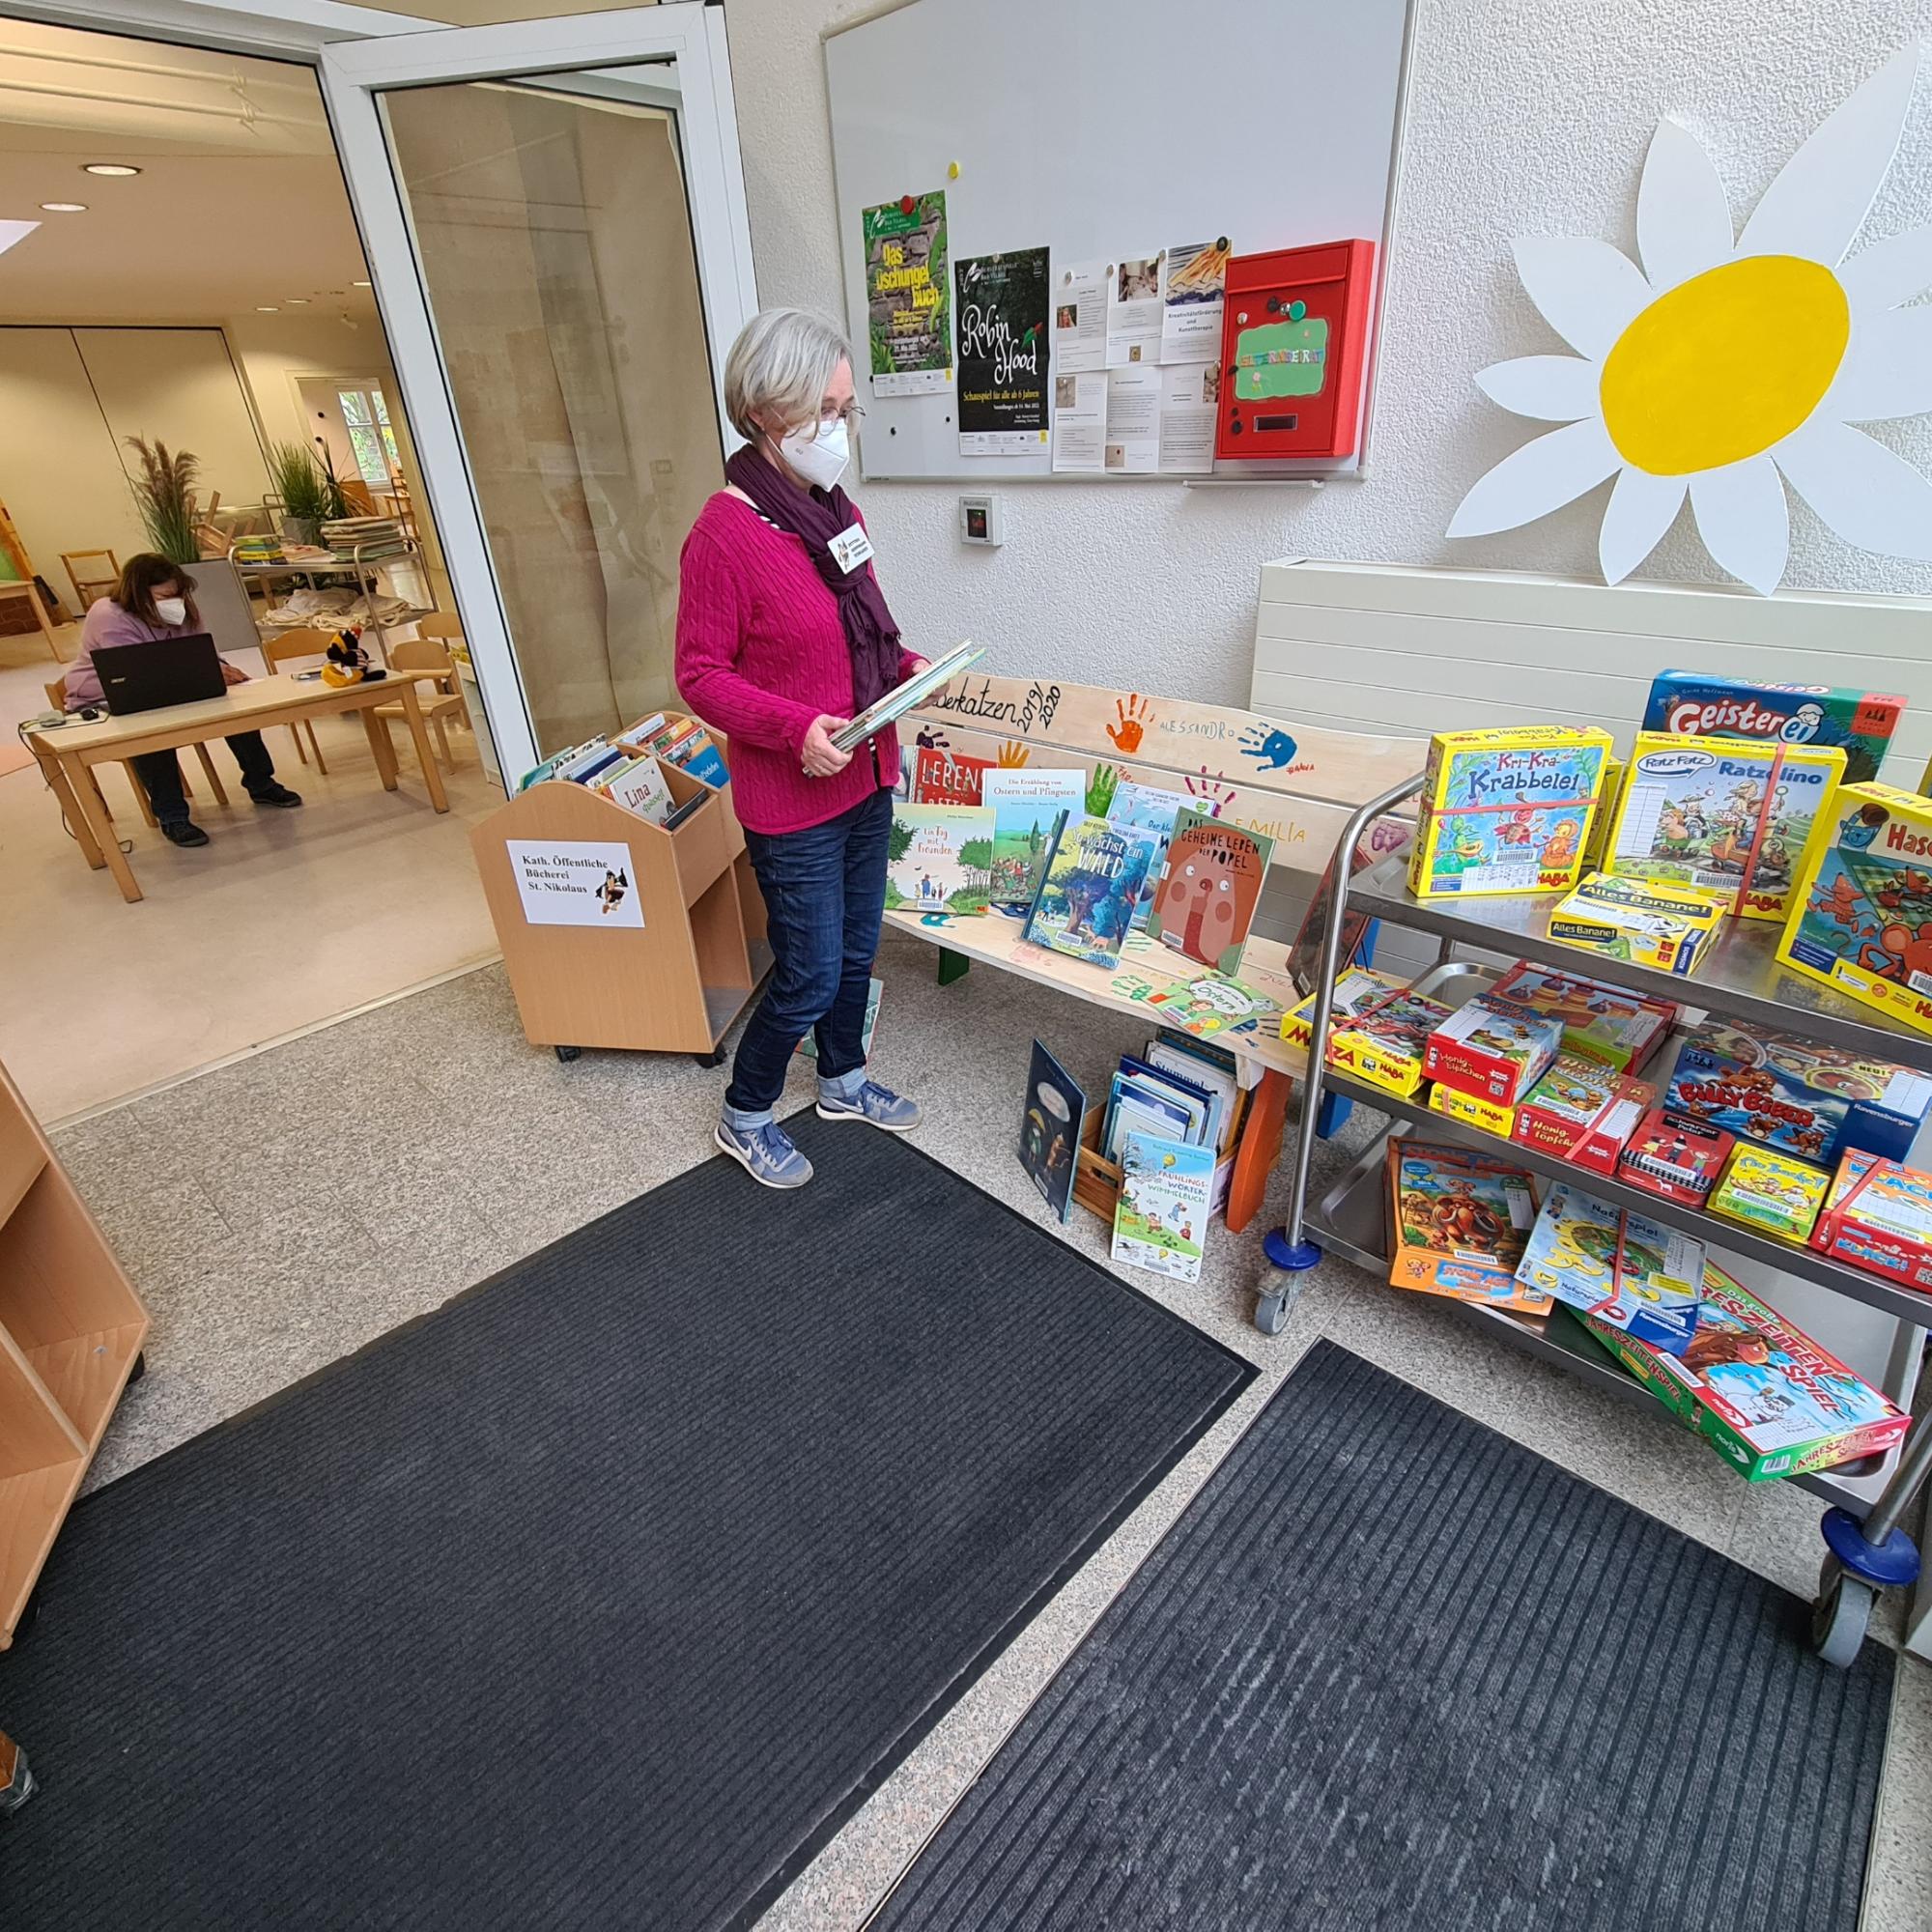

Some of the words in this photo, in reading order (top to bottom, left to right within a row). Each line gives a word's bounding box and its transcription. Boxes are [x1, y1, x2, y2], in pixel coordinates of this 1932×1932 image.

[882, 243, 903, 267] Das
[962, 303, 1011, 358] Robin
[993, 337, 1038, 385] Hood
[963, 389, 992, 403] Schauspiel
[933, 676, 1016, 724] erkatzen
[1645, 757, 1676, 769] Ratz
[1676, 754, 1707, 766] Fatz
[921, 757, 982, 795] LEBEN
[1467, 768, 1580, 800] Krabbelei
[624, 783, 651, 810] Lina
[993, 786, 1021, 796] Ostern
[1022, 786, 1037, 796] und
[1039, 786, 1076, 798] Pfingsten
[1187, 818, 1204, 829] DAS
[918, 841, 952, 855] Freunden
[1126, 845, 1144, 859] ein
[1180, 829, 1223, 847] GEHEIME
[1226, 836, 1261, 855] LEBEN
[522, 855, 551, 867] Kath.
[553, 855, 609, 868] Öffentliche
[1077, 846, 1124, 878] WALD
[1210, 848, 1248, 869] POPEL
[526, 867, 570, 880] Bücherei
[527, 881, 542, 891] St.
[544, 882, 587, 894] Nikolaus
[1582, 886, 1627, 901] Alles
[1629, 895, 1708, 915] Banane!
[1552, 922, 1576, 933] Alles
[1577, 924, 1616, 938] Banane!
[1678, 945, 1690, 970] KOSMOS
[1381, 1050, 1412, 1067] HABA
[1858, 1065, 1887, 1076] NEU!
[1379, 1063, 1405, 1080] HABA
[1480, 1107, 1504, 1122] HABA
[1853, 1103, 1916, 1128] Ravensburger
[1532, 1120, 1570, 1137] Honig-
[1592, 1204, 1660, 1237] Natuspiel
[1726, 1290, 1747, 1304] Das
[1747, 1302, 1781, 1324] große
[1638, 1312, 1690, 1339] Ravensburger
[1700, 1285, 1837, 1378] RESZEITEN
[1585, 1316, 1682, 1404] JAHRESZEITENSPIEL
[1778, 1364, 1841, 1412] SPIEL
[1716, 1433, 1738, 1454] noris
